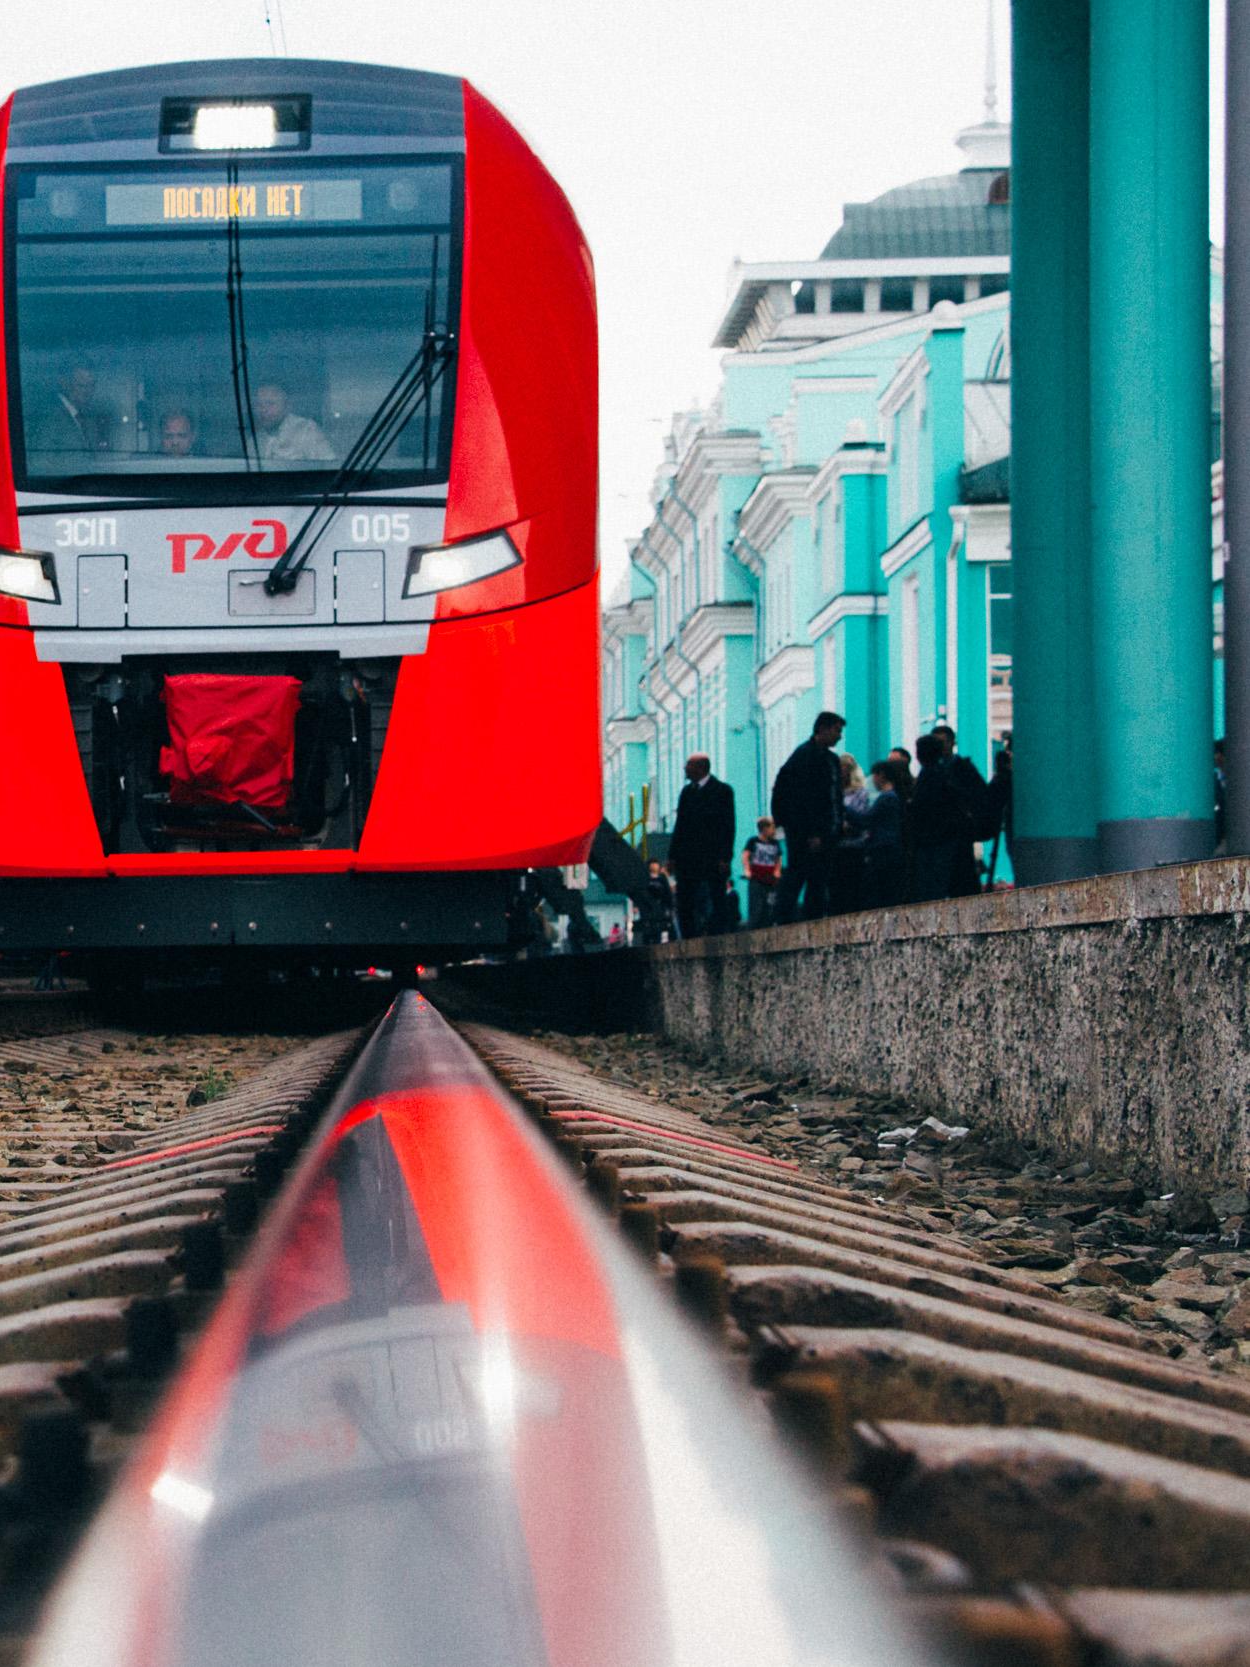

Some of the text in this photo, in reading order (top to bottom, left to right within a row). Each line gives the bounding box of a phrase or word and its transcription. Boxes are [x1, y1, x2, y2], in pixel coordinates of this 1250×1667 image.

[163, 184, 303, 220] ПОСАДКИ НЕТ
[351, 513, 411, 542] 005
